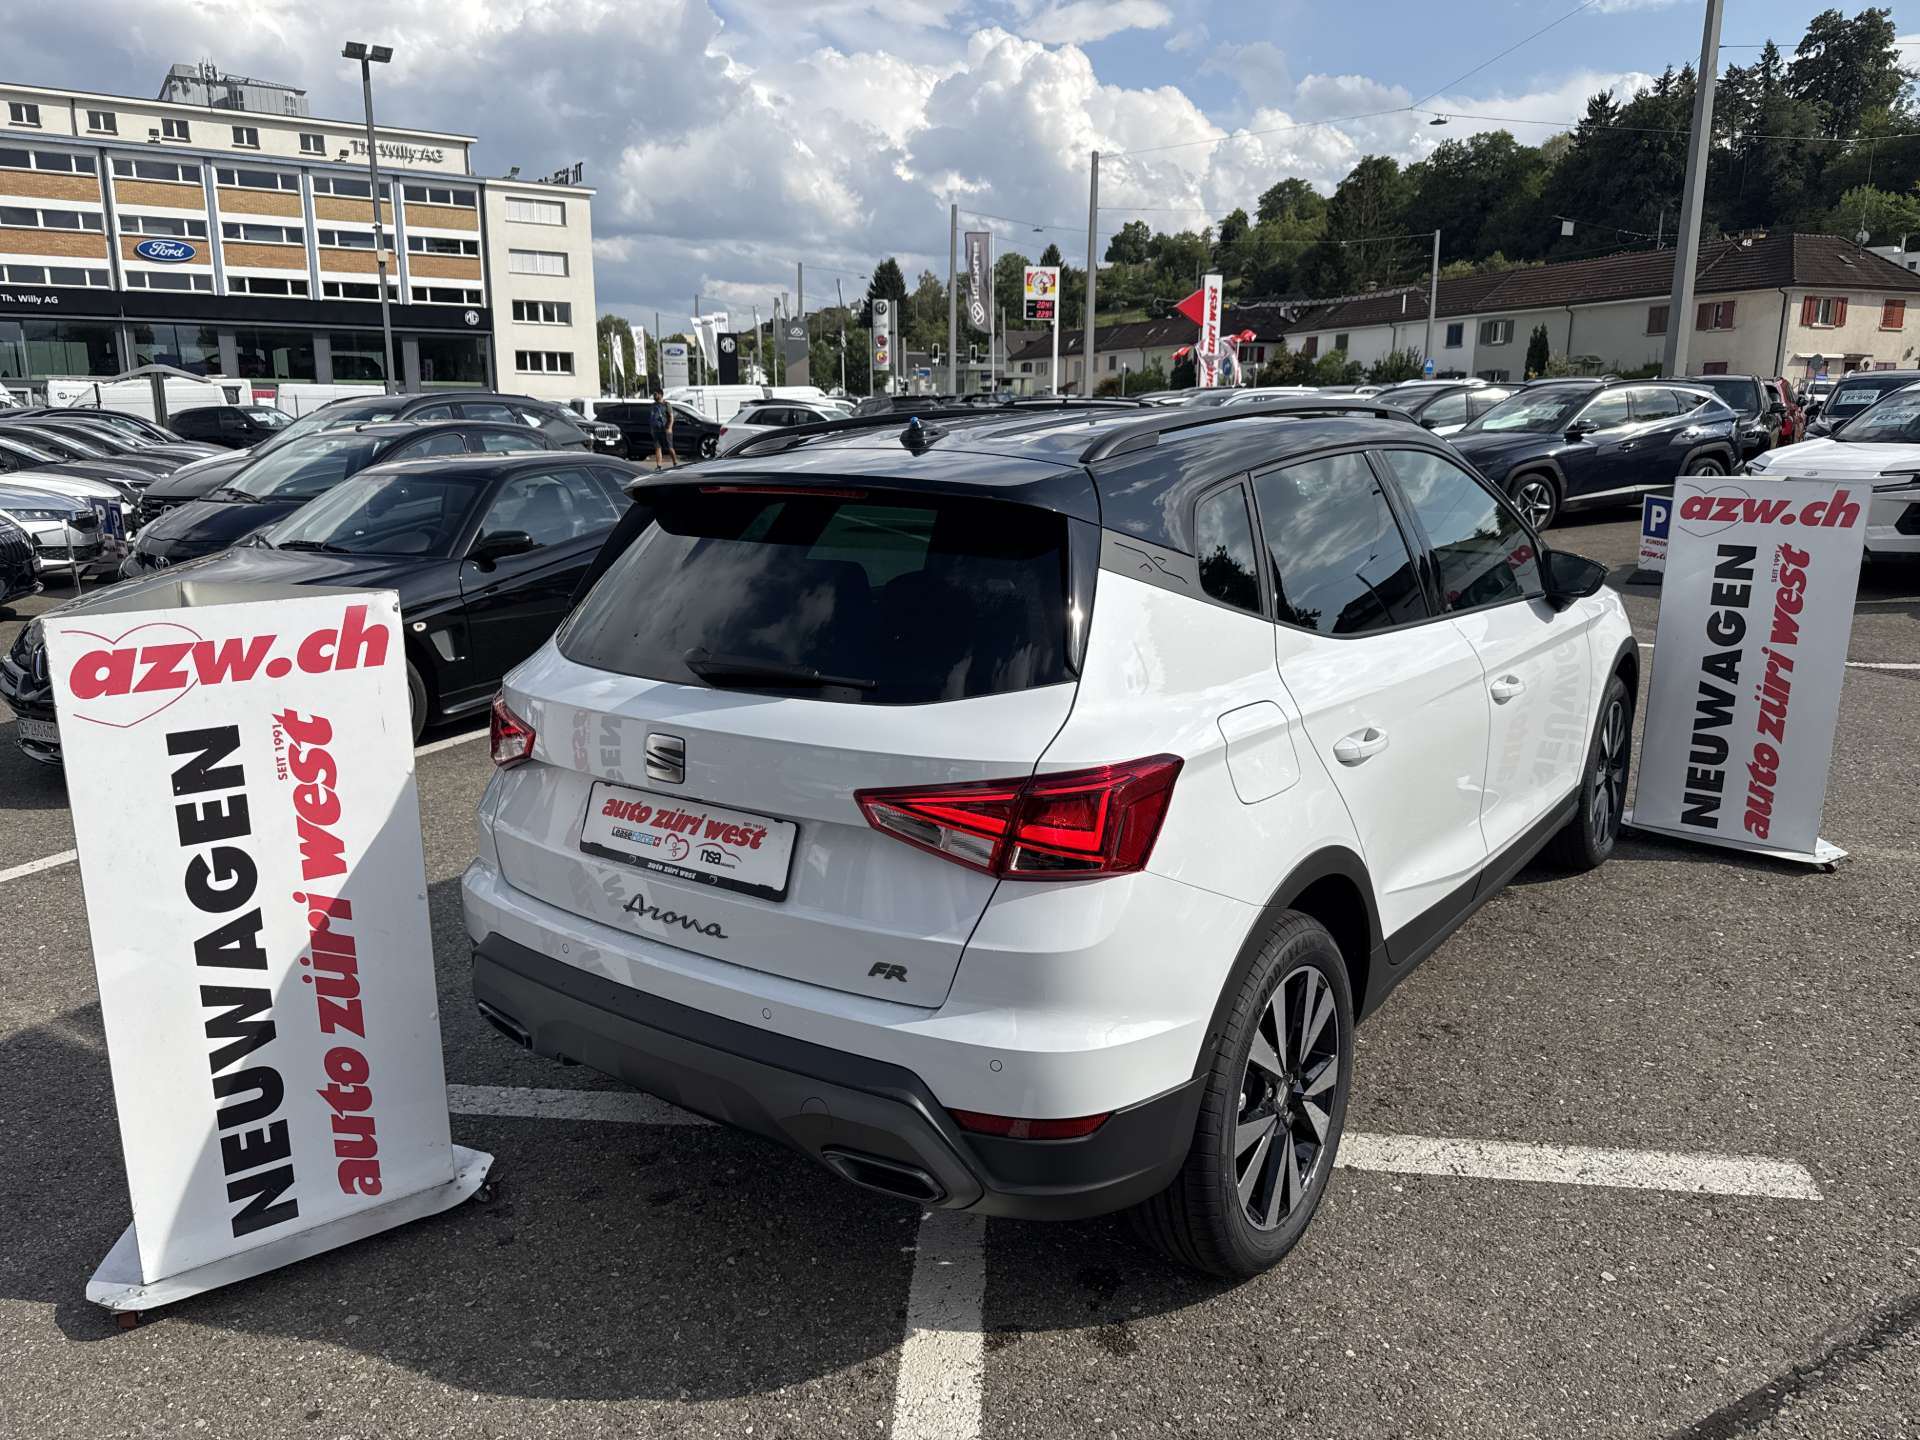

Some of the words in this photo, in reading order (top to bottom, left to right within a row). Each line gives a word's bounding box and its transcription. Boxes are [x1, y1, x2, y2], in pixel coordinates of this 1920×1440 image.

[149, 242, 185, 257] Ford
[1741, 238, 1753, 247] 48
[0, 293, 16, 303] Th.
[17, 294, 42, 305] Willy
[44, 295, 59, 304] AG
[1650, 504, 1667, 532] P
[1680, 489, 1861, 528] azw.ch
[1770, 542, 1811, 646] west
[70, 605, 389, 700] azw.ch
[1680, 543, 1758, 829] NEUWAGEN
[1749, 646, 1795, 744] züri
[272, 724, 284, 752] 1991
[276, 756, 288, 781] SEIT
[1743, 742, 1781, 840] auto
[271, 708, 350, 882] west
[601, 798, 653, 824] auto
[650, 808, 707, 835] züri
[704, 819, 767, 849] west
[647, 861, 663, 872] auto
[663, 865, 679, 876] züri
[679, 870, 697, 880] west
[700, 849, 721, 864] nsa
[623, 893, 728, 938] Arona
[165, 724, 300, 1239] NEUWAGEN
[292, 892, 366, 1039] züri
[867, 961, 908, 983] FR
[316, 1046, 383, 1196] auto
